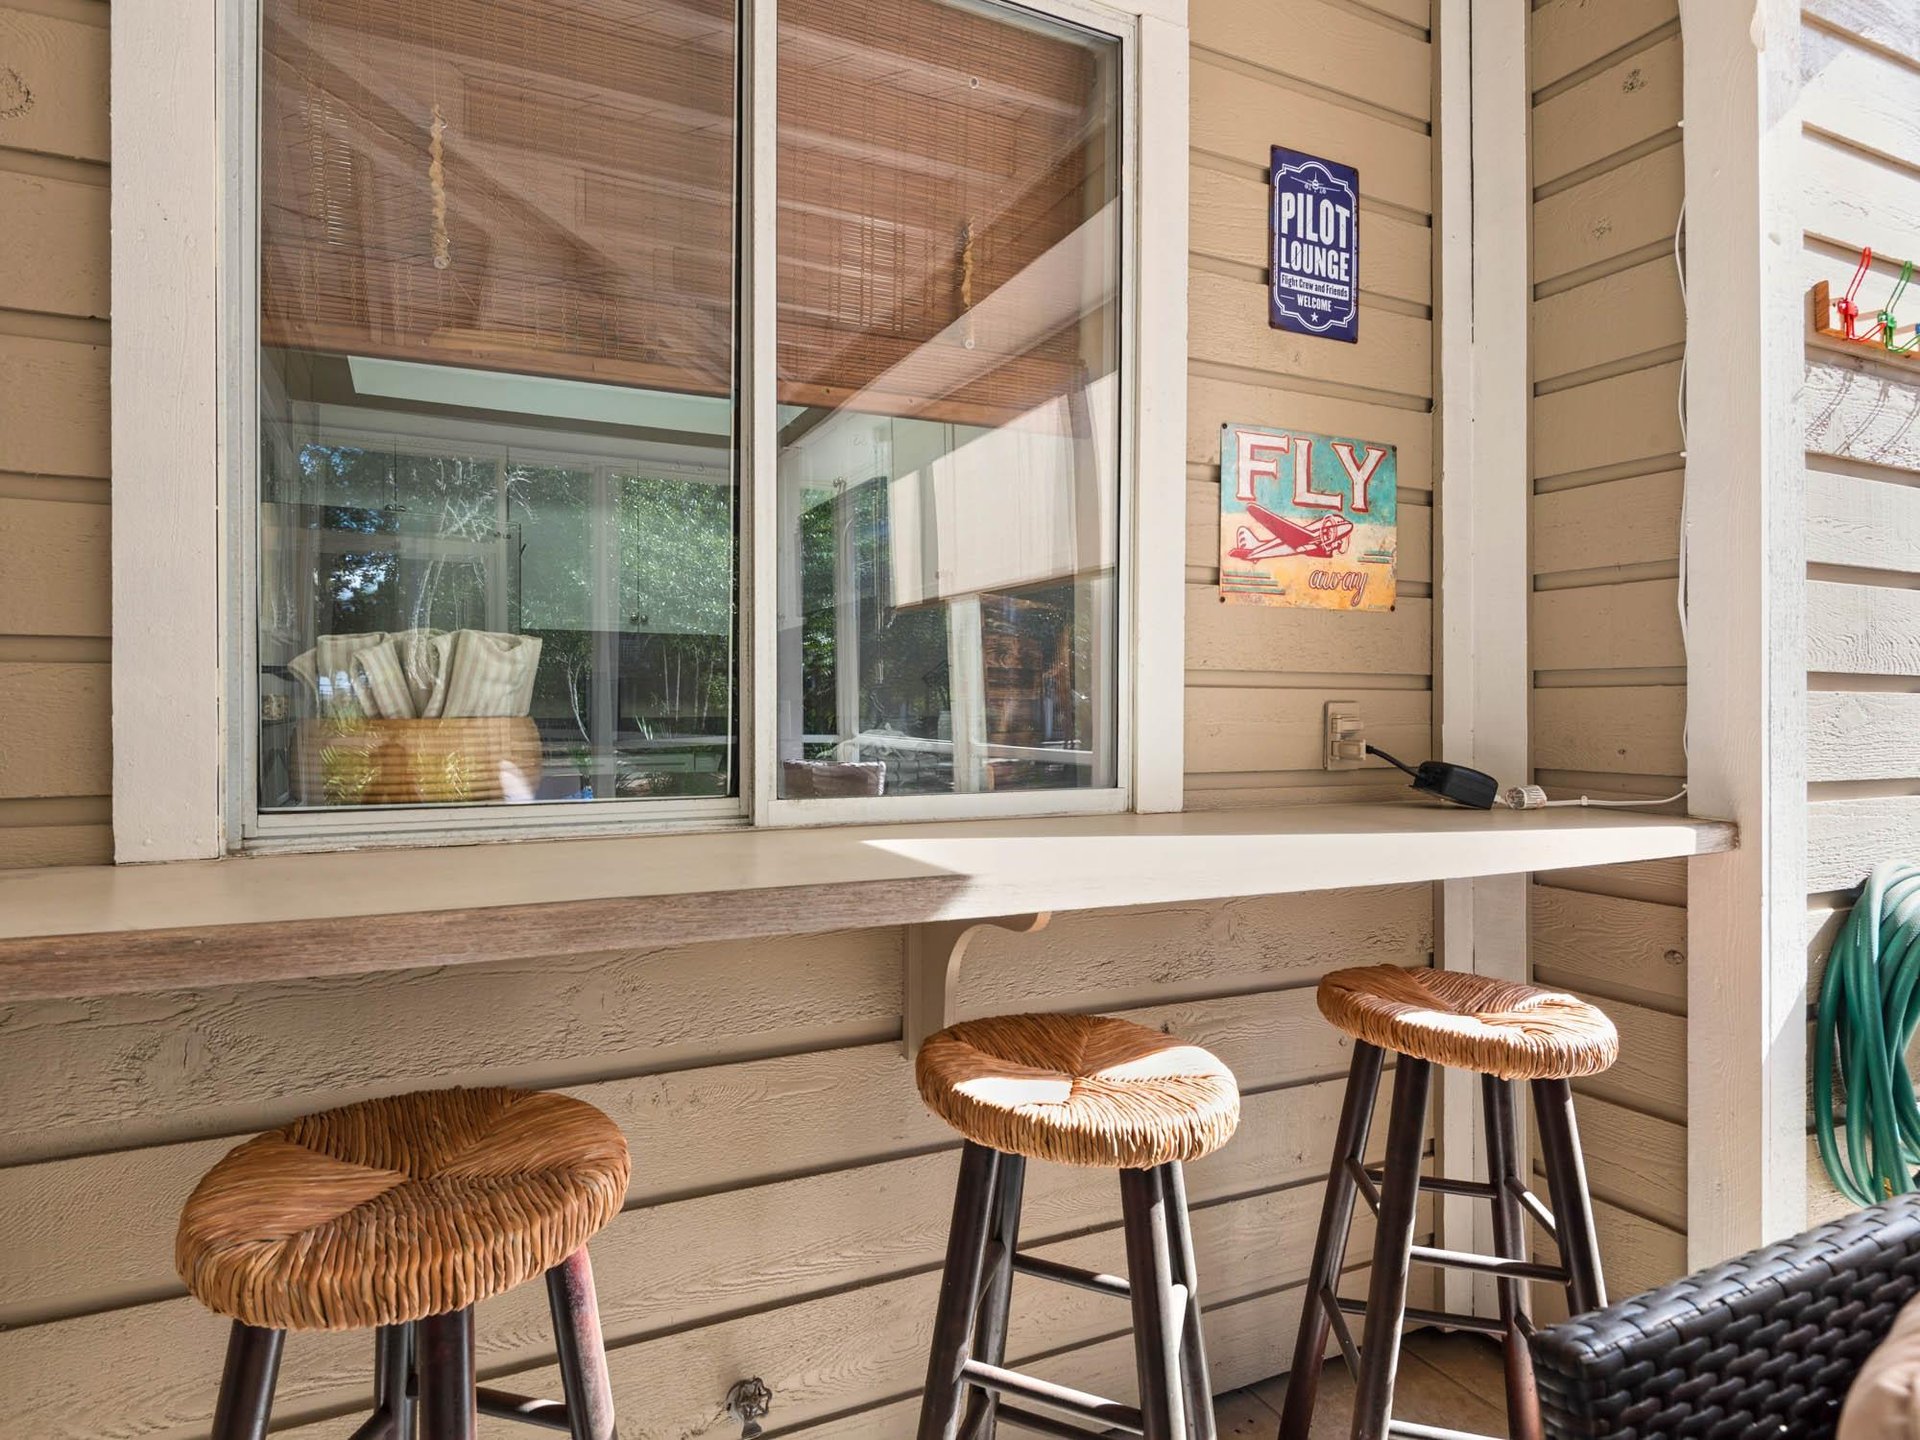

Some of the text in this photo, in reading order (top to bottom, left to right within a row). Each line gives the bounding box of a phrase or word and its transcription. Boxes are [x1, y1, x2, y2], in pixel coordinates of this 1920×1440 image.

[1281, 192, 1350, 249] PILOT
[1280, 237, 1350, 282] LOUNGE
[1281, 274, 1348, 298] Flight Crew and Friends
[1297, 293, 1332, 312] WELCOME
[1235, 430, 1387, 513] FLY
[1308, 569, 1368, 607] away
